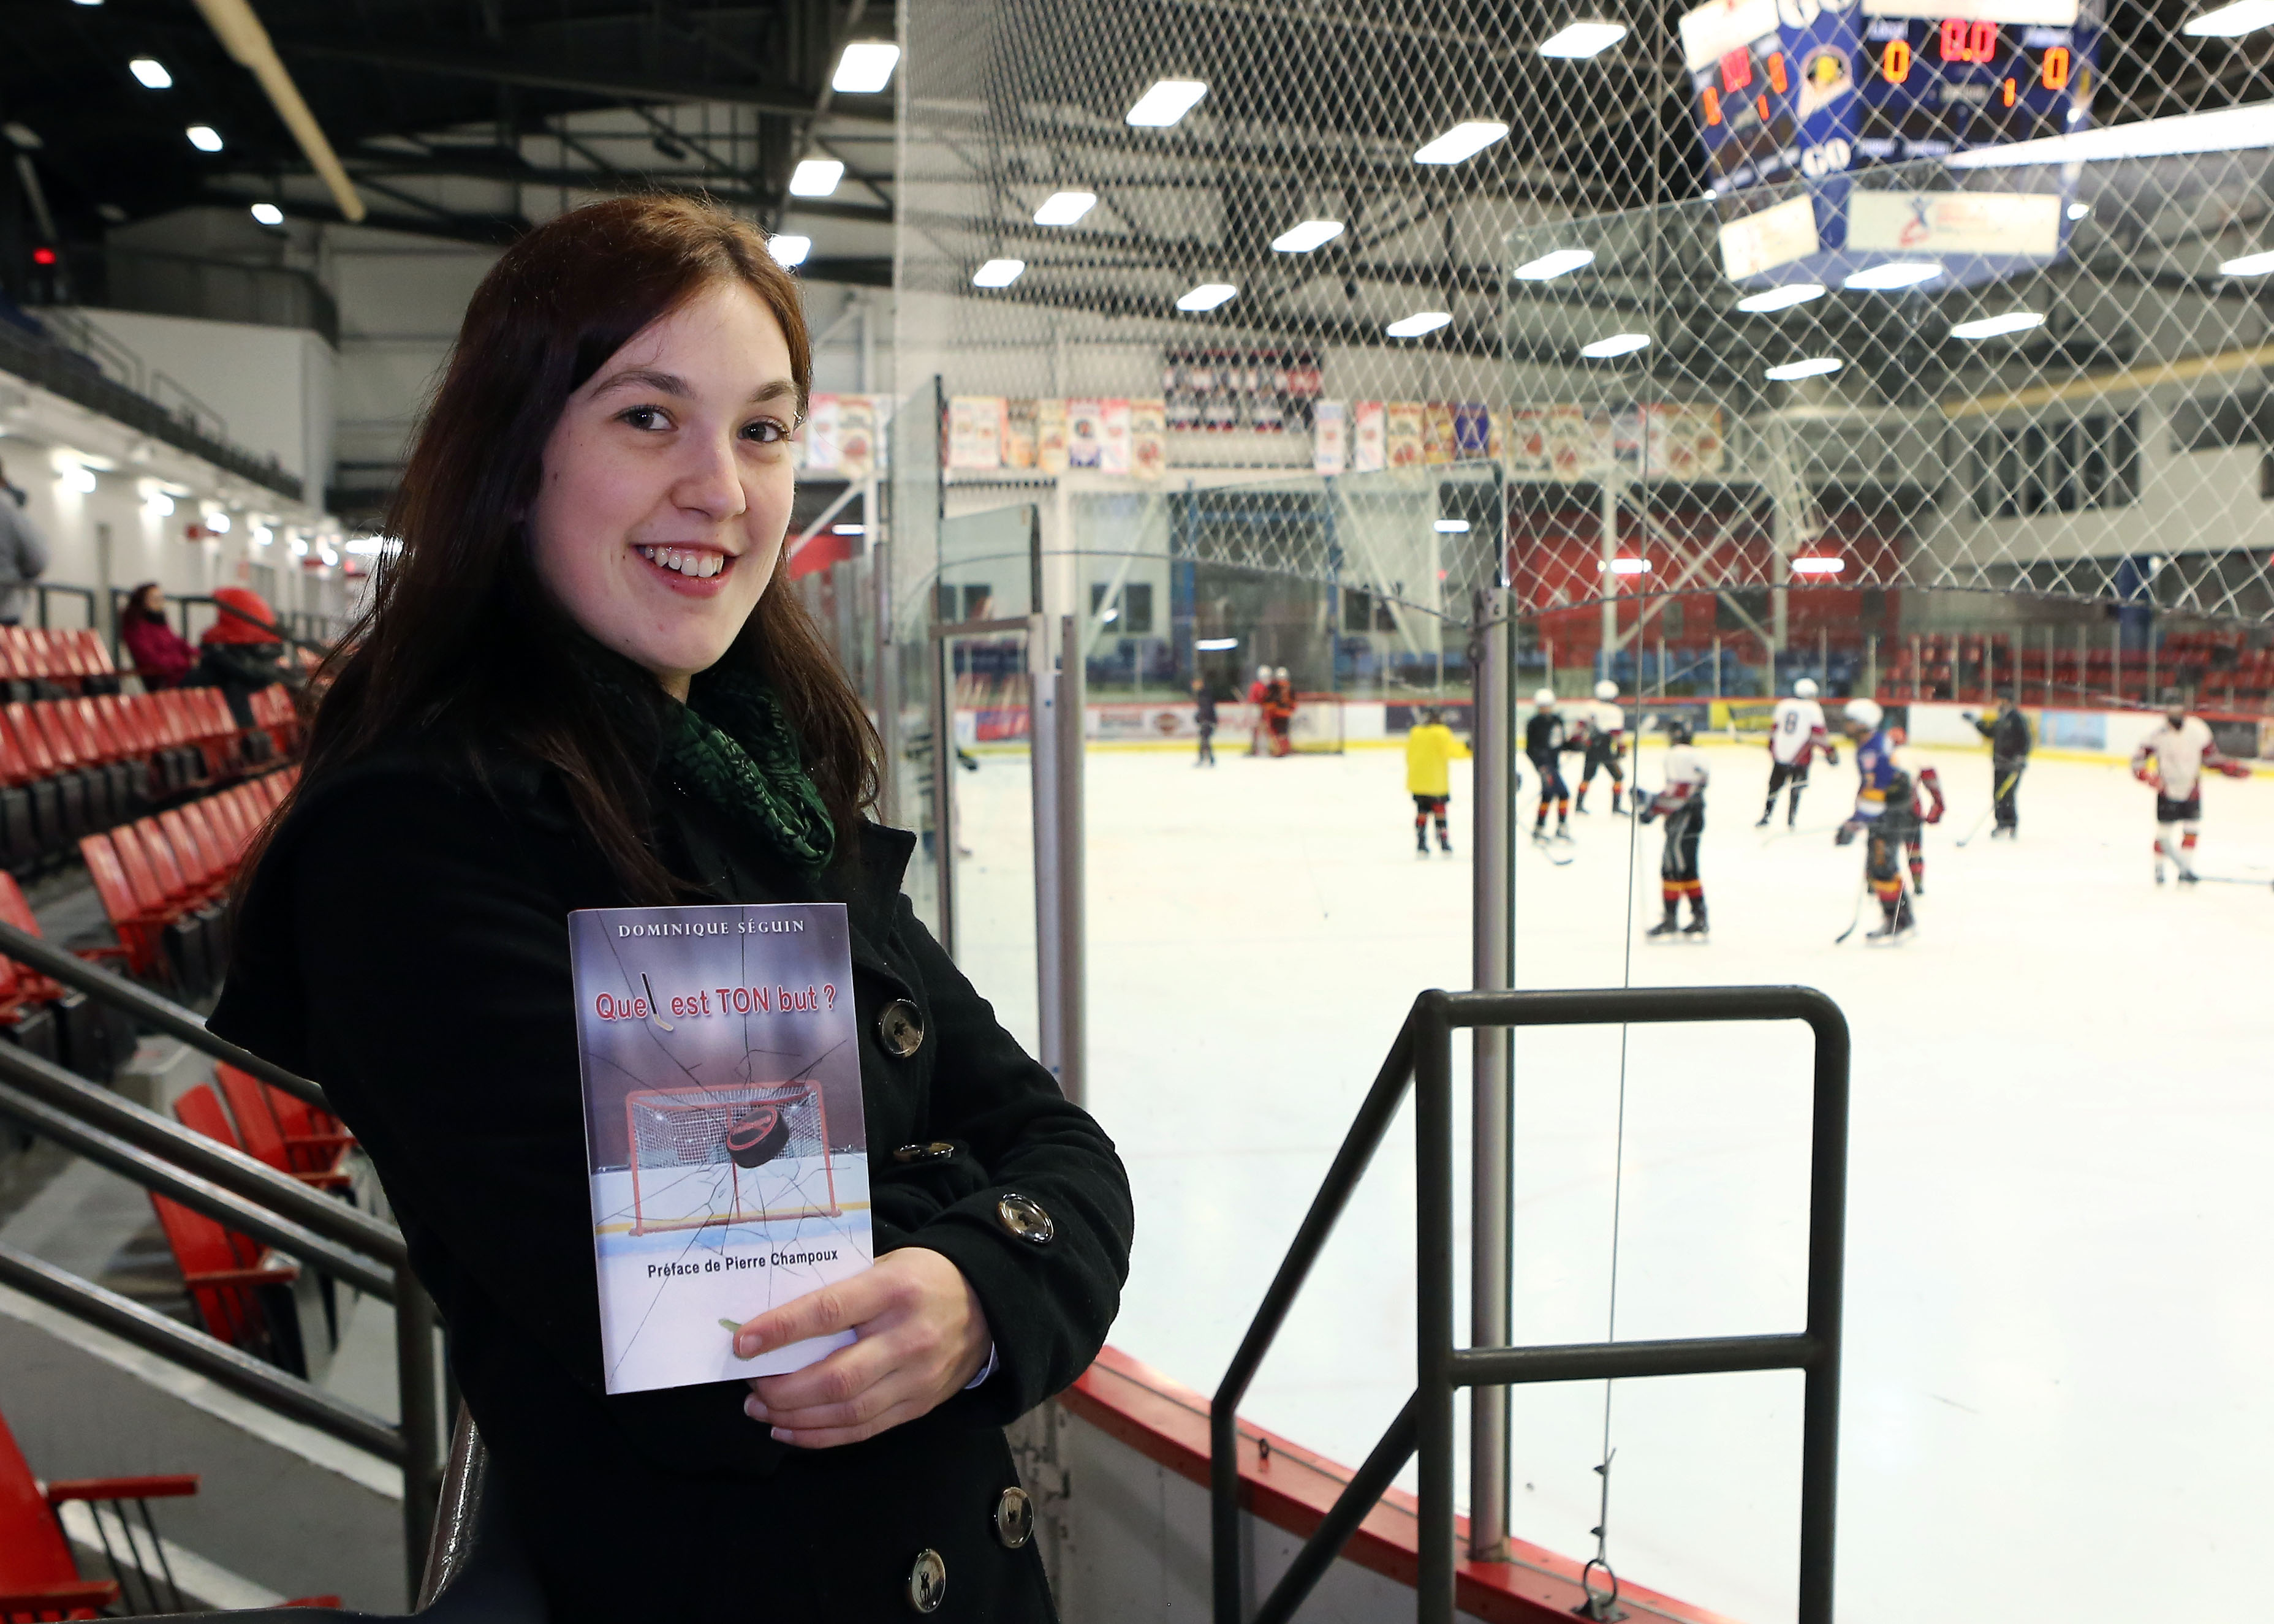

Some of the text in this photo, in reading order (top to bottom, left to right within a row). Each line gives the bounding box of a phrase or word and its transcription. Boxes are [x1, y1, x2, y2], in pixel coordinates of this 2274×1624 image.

[618, 918, 805, 938] DOMINIQUE SÉGUIN
[670, 989, 711, 1017] est
[715, 986, 770, 1014] TON
[778, 984, 818, 1012] but
[823, 983, 836, 1011] ?
[648, 1249, 839, 1278] Préface de Pierre Champoux
